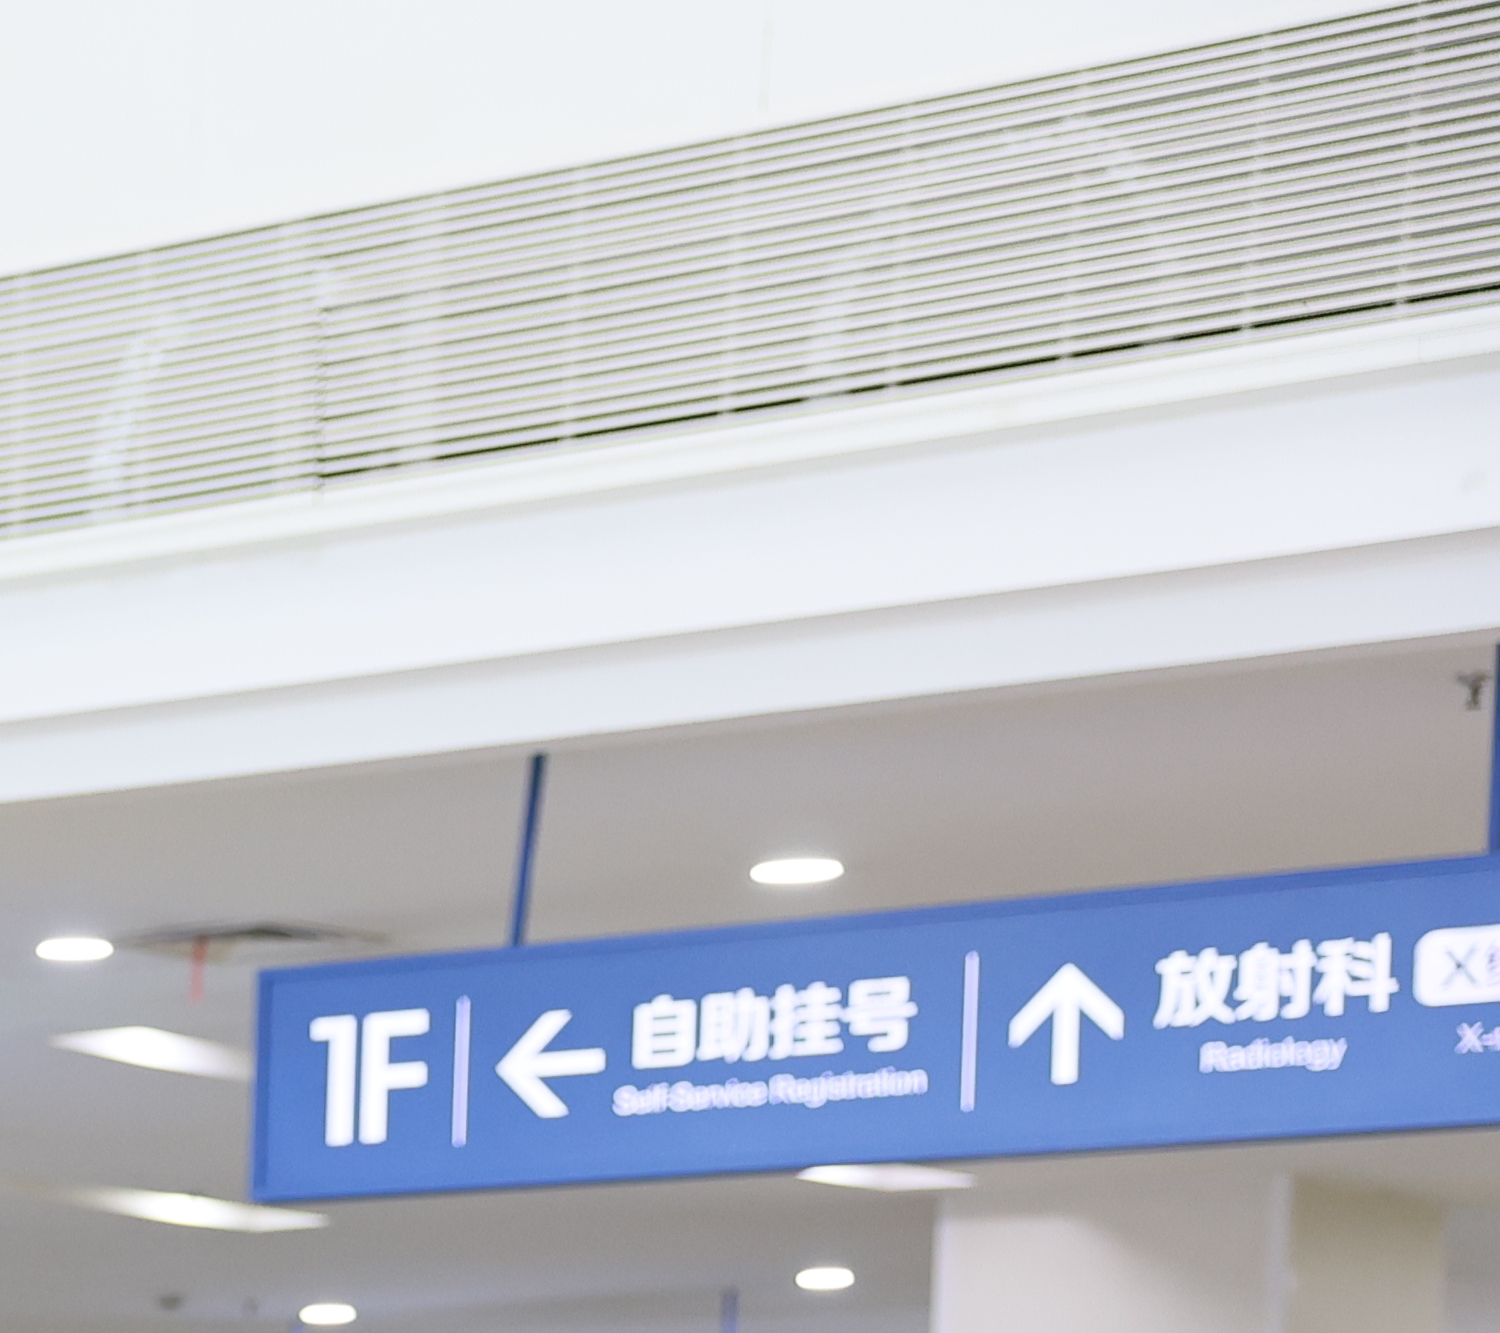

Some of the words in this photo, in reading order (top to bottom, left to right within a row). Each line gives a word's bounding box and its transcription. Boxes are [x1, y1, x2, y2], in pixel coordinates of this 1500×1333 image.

[1153, 931, 1399, 1030] 放射科
[308, 1007, 431, 1148] 1F
[630, 973, 918, 1070] 自助挂号
[769, 1066, 928, 1109] Registration
[1198, 1034, 1349, 1074] Radiology
